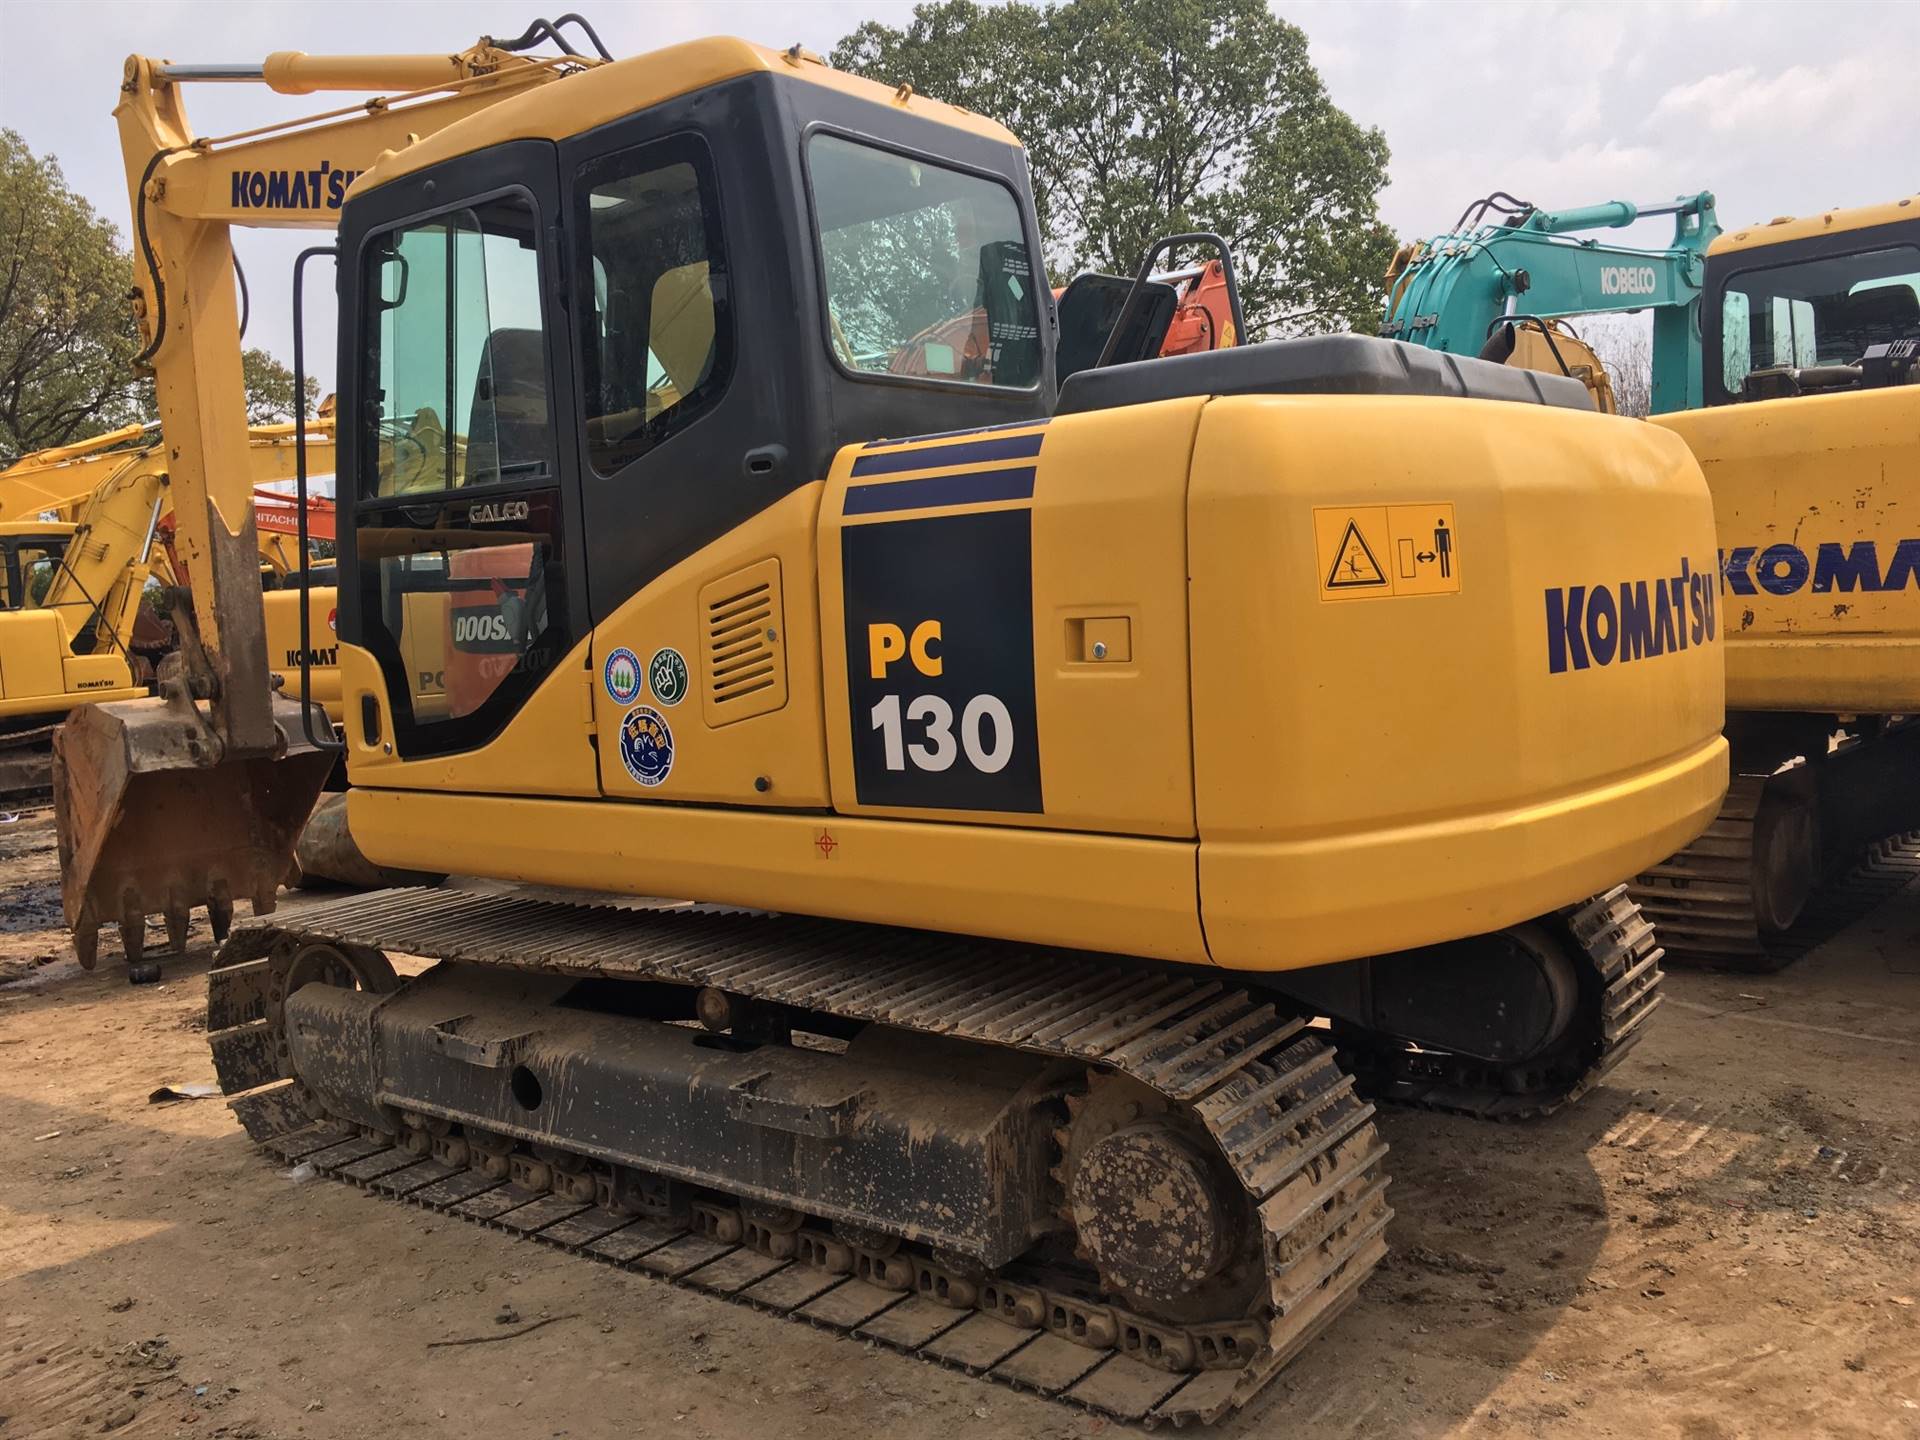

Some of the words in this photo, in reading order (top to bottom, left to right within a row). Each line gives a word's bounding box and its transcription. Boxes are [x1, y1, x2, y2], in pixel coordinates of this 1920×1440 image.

[1600, 266, 1656, 295] KOBELCO
[469, 501, 529, 523] GALEO
[1544, 556, 1715, 674] KOMATSU
[868, 619, 943, 679] PC
[77, 679, 114, 688] KOMATSU
[871, 693, 1014, 774] 130
